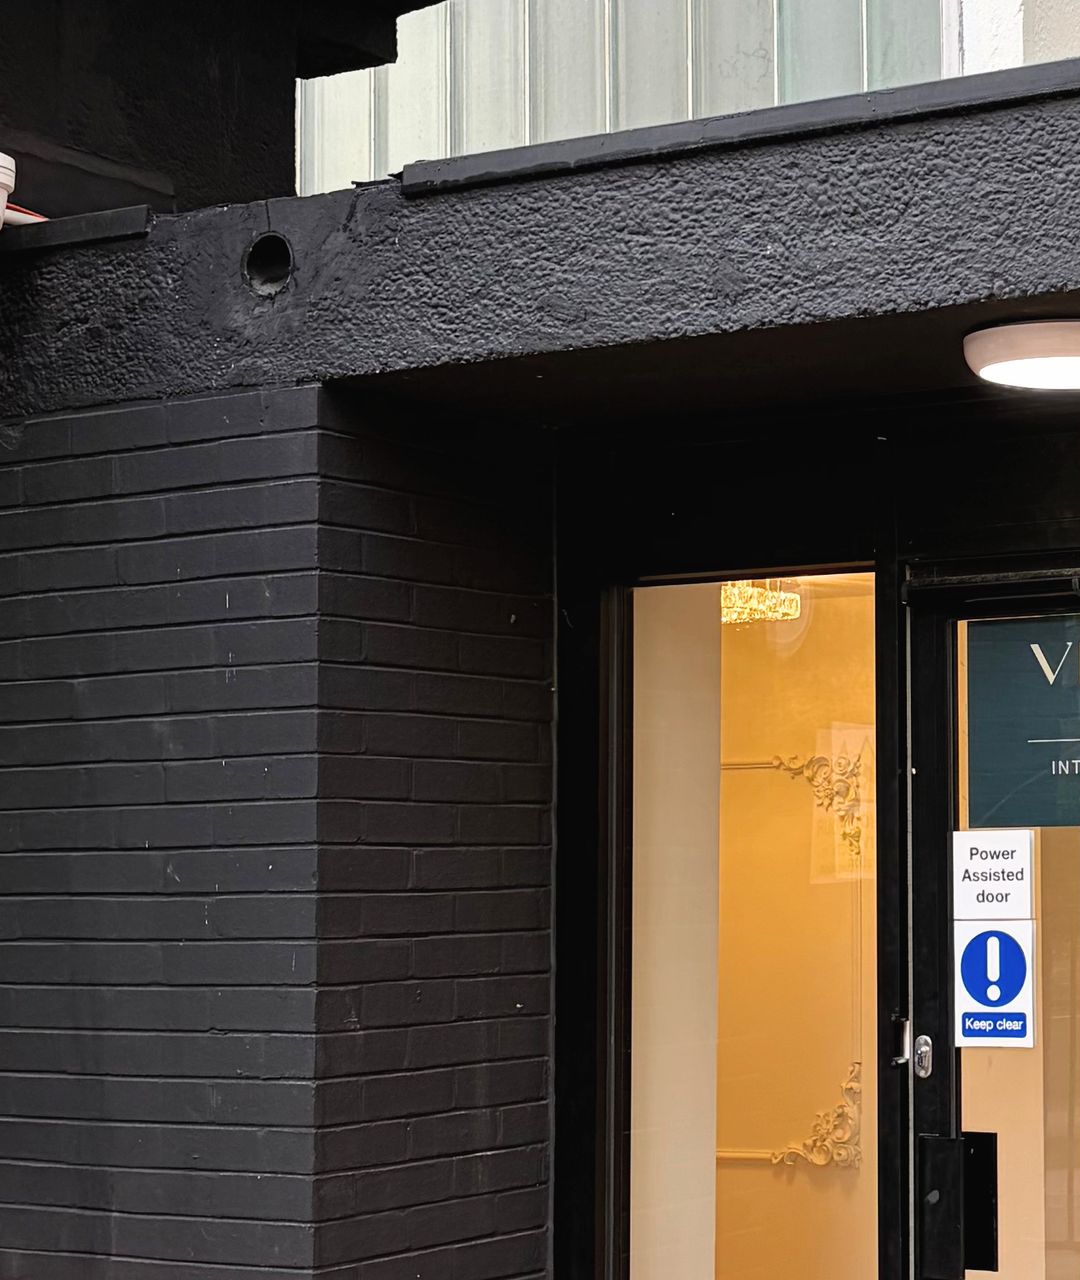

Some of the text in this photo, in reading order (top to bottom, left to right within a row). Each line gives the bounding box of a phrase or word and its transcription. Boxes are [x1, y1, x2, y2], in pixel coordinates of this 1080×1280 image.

[969, 847, 1017, 860] Power
[962, 868, 1024, 881] Assisted
[976, 890, 1011, 903] door
[964, 1018, 1023, 1032] Keep clear
